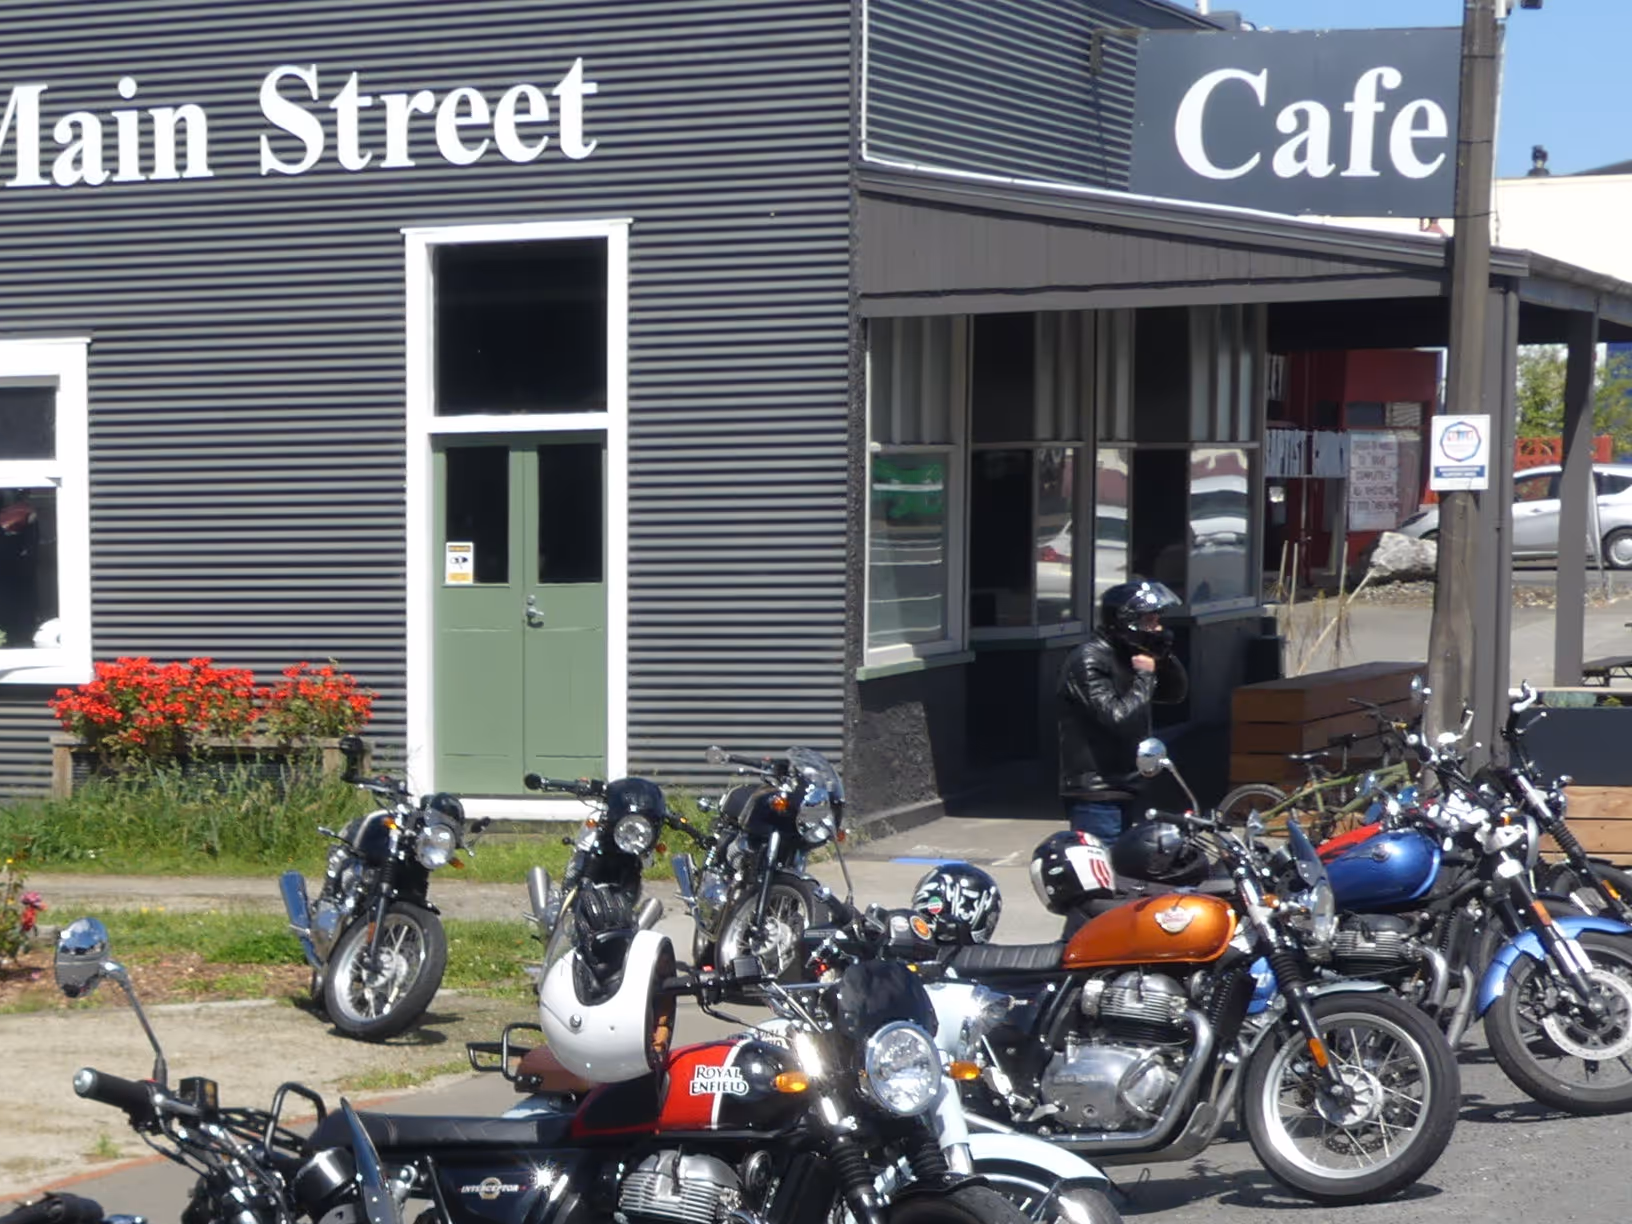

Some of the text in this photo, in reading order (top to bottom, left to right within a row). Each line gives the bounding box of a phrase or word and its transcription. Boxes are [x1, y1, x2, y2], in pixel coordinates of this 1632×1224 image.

[259, 57, 598, 176] Street
[1174, 65, 1449, 180] Cafe
[695, 1065, 742, 1080] ROYAL
[690, 1080, 749, 1095] ENFIELD
[460, 1183, 520, 1194] INTERCEPTOR
